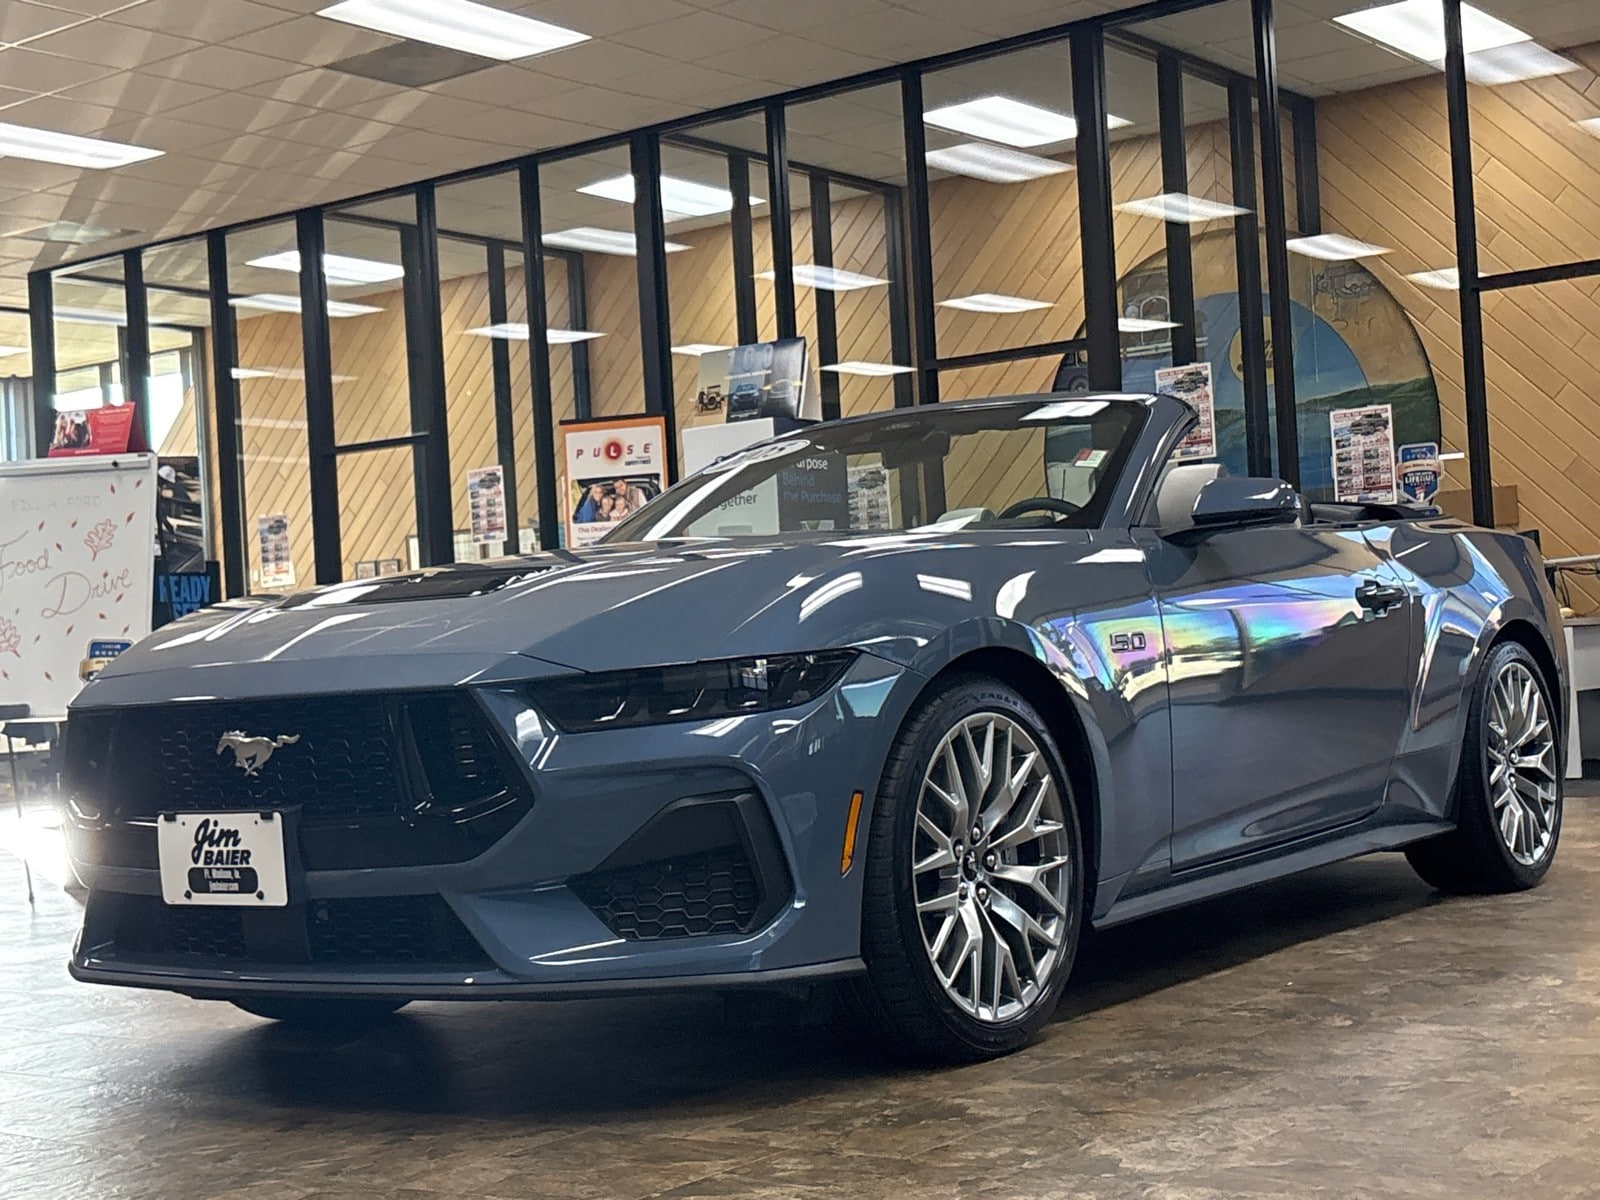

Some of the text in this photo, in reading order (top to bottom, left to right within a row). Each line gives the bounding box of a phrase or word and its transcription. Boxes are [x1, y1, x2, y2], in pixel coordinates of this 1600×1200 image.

[576, 442, 652, 460] PULSE
[792, 458, 828, 472] urpose
[782, 471, 815, 487] Behind
[720, 493, 758, 511] gether
[783, 490, 842, 504] the Purchase
[0, 530, 52, 591] Food
[41, 568, 132, 619] Drive
[191, 818, 241, 865] Jim
[203, 849, 251, 866] BAIER
